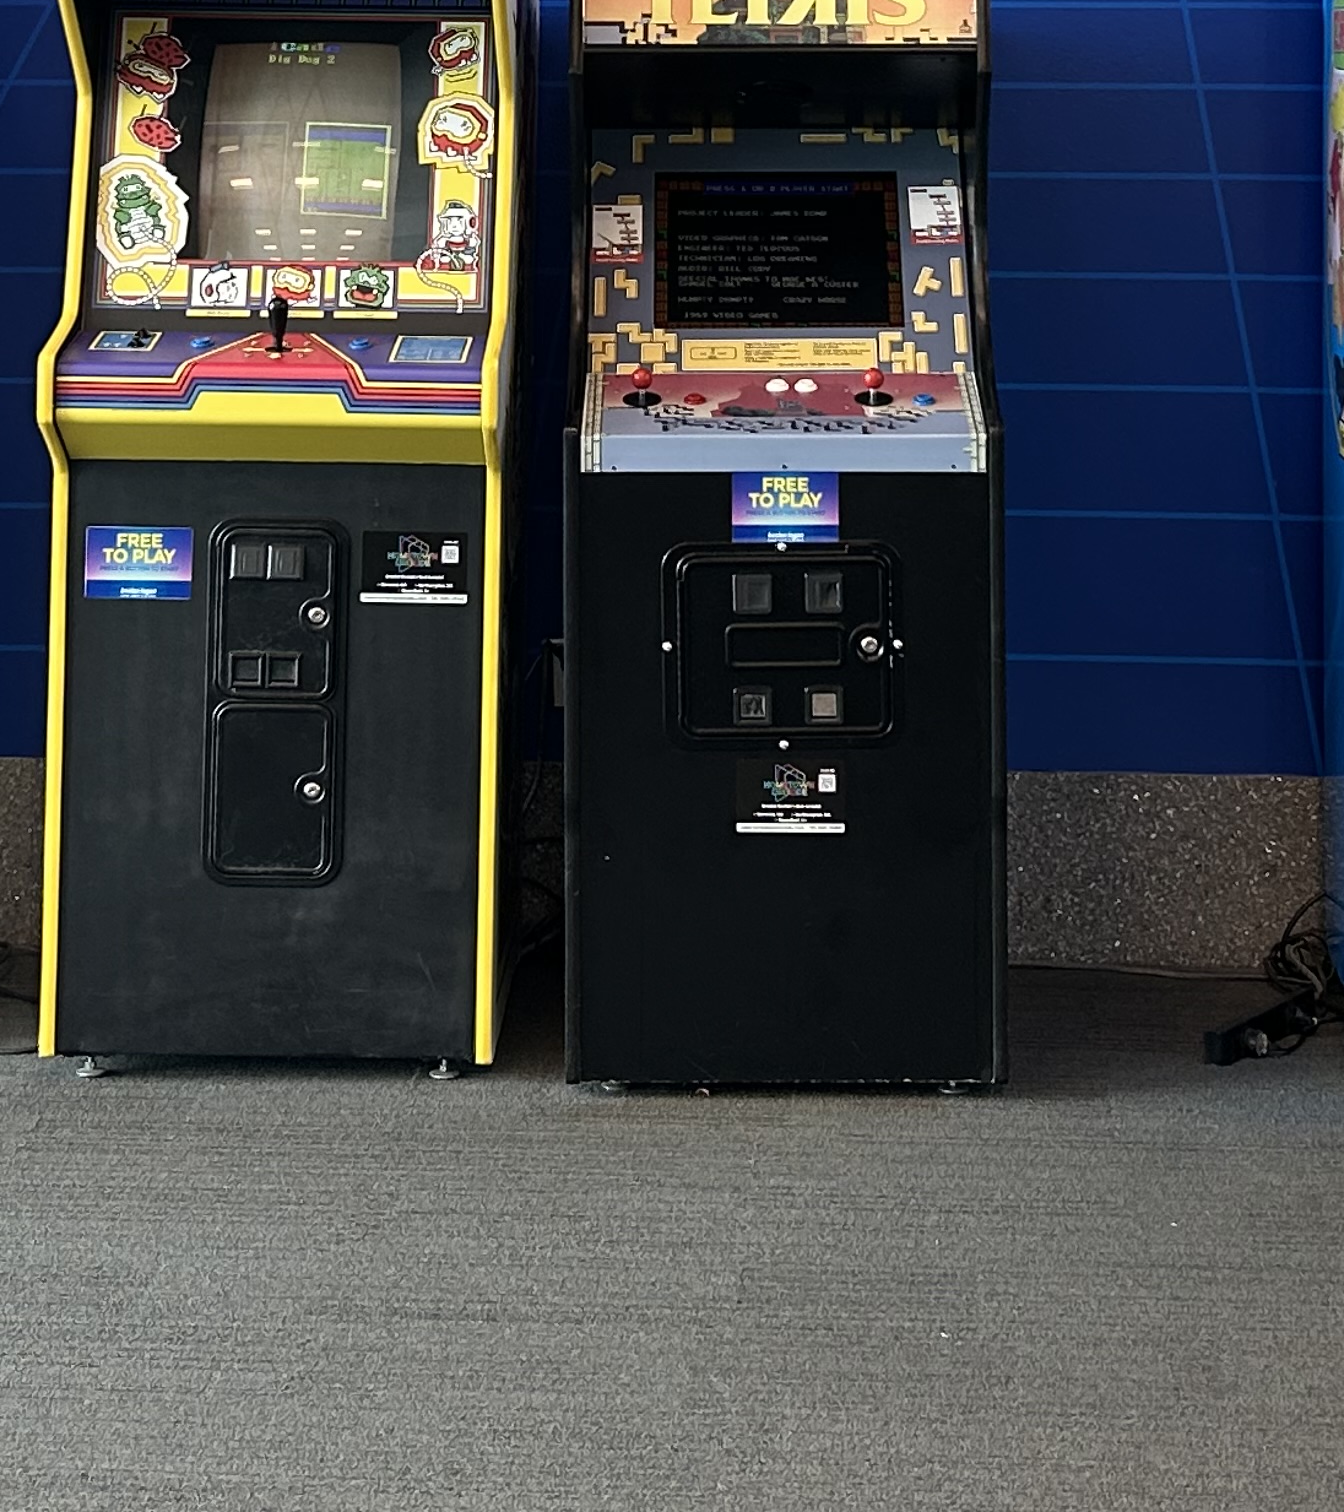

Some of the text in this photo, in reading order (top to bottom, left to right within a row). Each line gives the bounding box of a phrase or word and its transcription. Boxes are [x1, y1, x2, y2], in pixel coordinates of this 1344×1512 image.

[268, 54, 336, 65] Dig Dug 2
[762, 477, 809, 493] FREE
[748, 492, 823, 508] TO PLAY
[117, 533, 164, 548] FREE
[102, 548, 176, 564] TO PLAY
